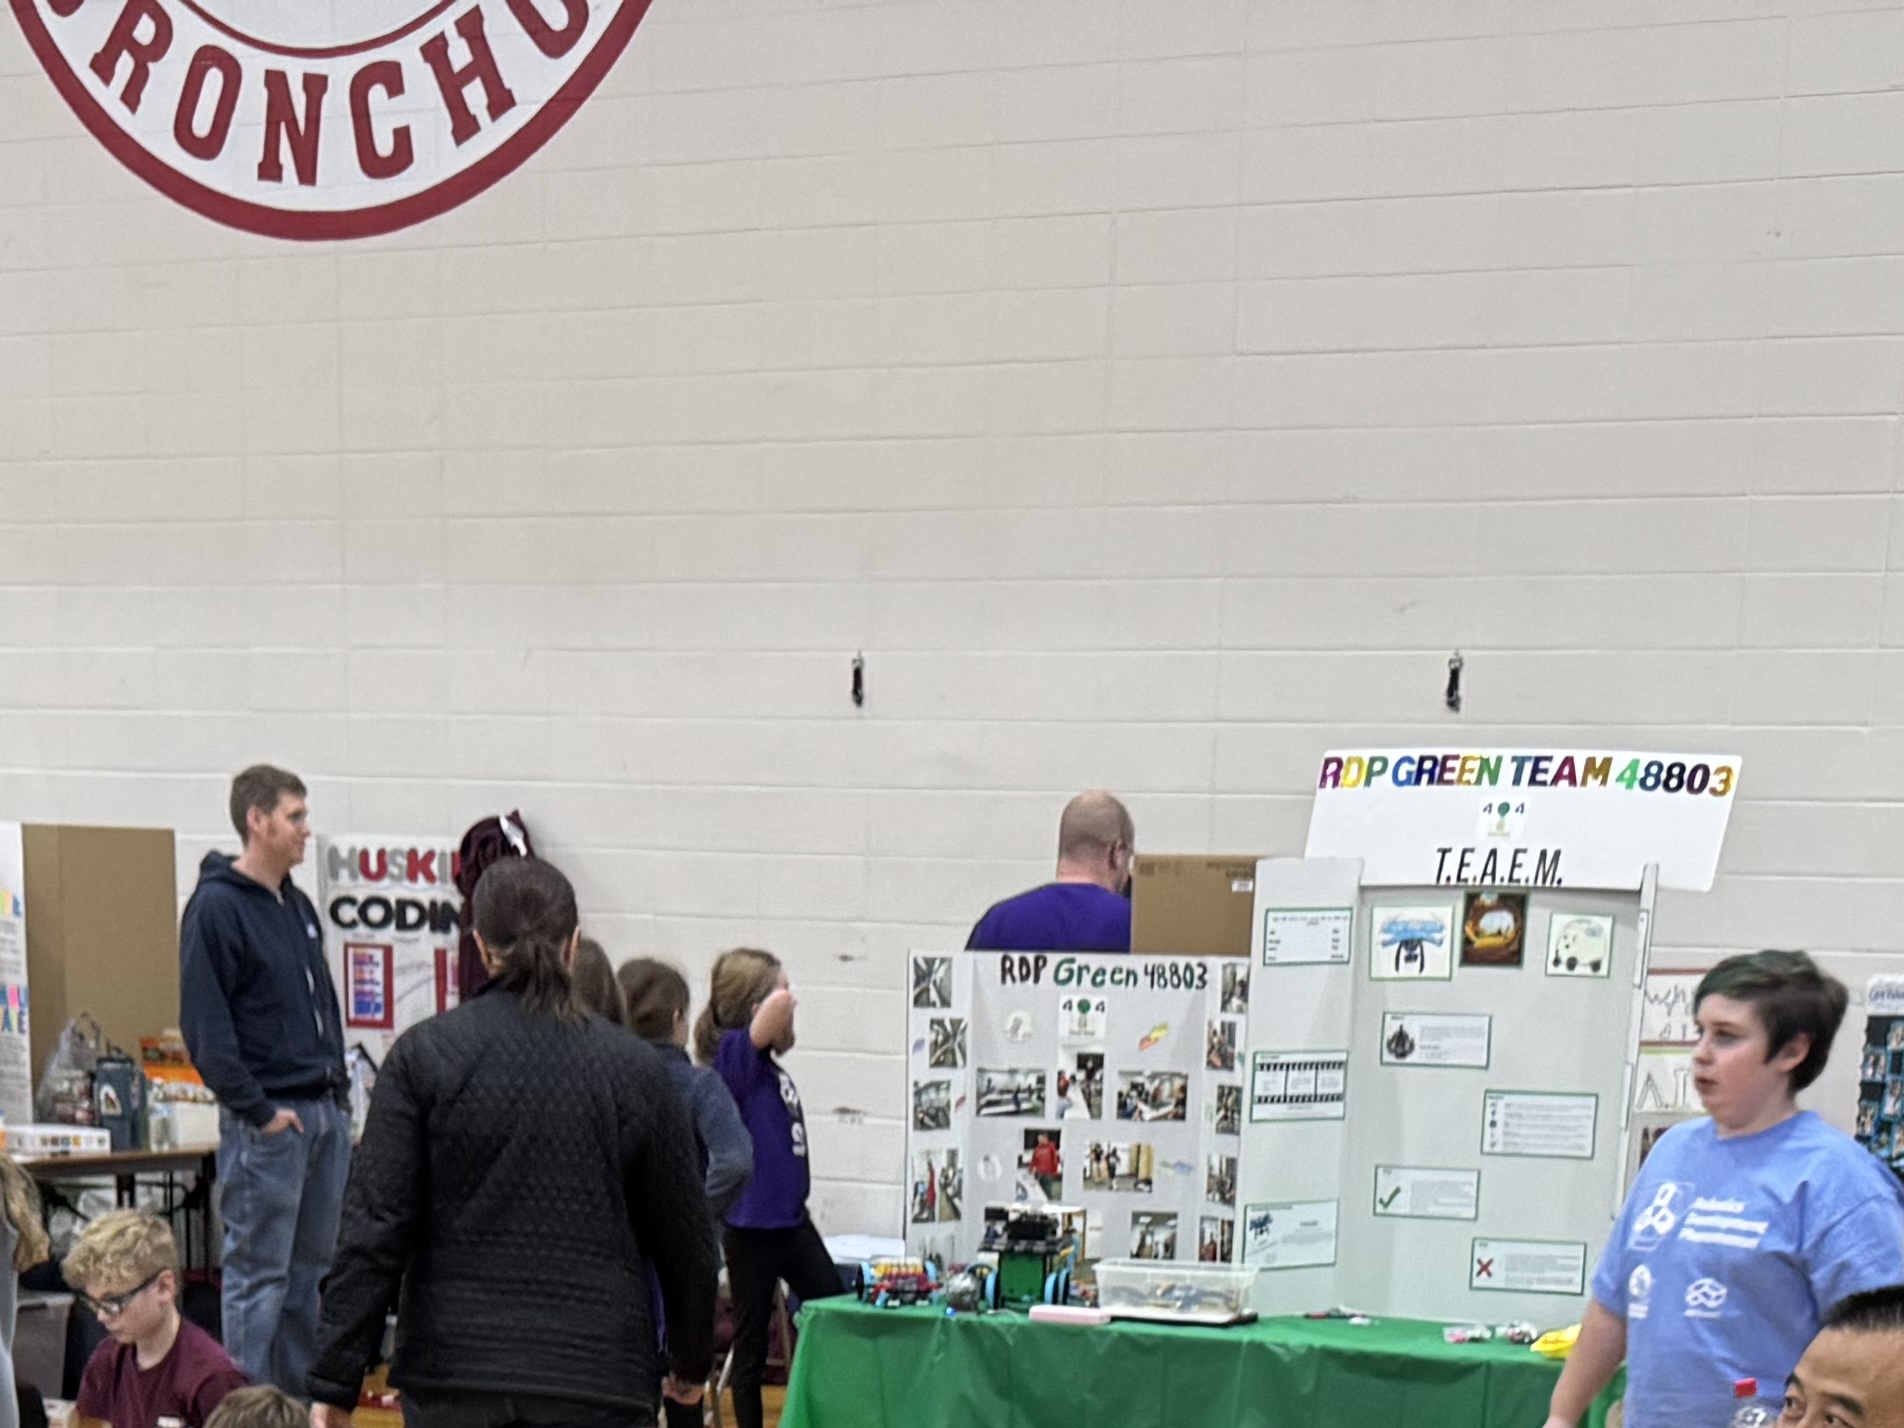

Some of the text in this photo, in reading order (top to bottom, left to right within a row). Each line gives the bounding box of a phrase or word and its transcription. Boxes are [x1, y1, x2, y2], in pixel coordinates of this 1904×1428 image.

[1318, 754, 1735, 798] RDP GREEN TEAM 48803
[1435, 847, 1564, 886] T.E.A.E.M.
[329, 895, 462, 934] CODIN
[1000, 954, 1208, 990] RDP Green 48803
